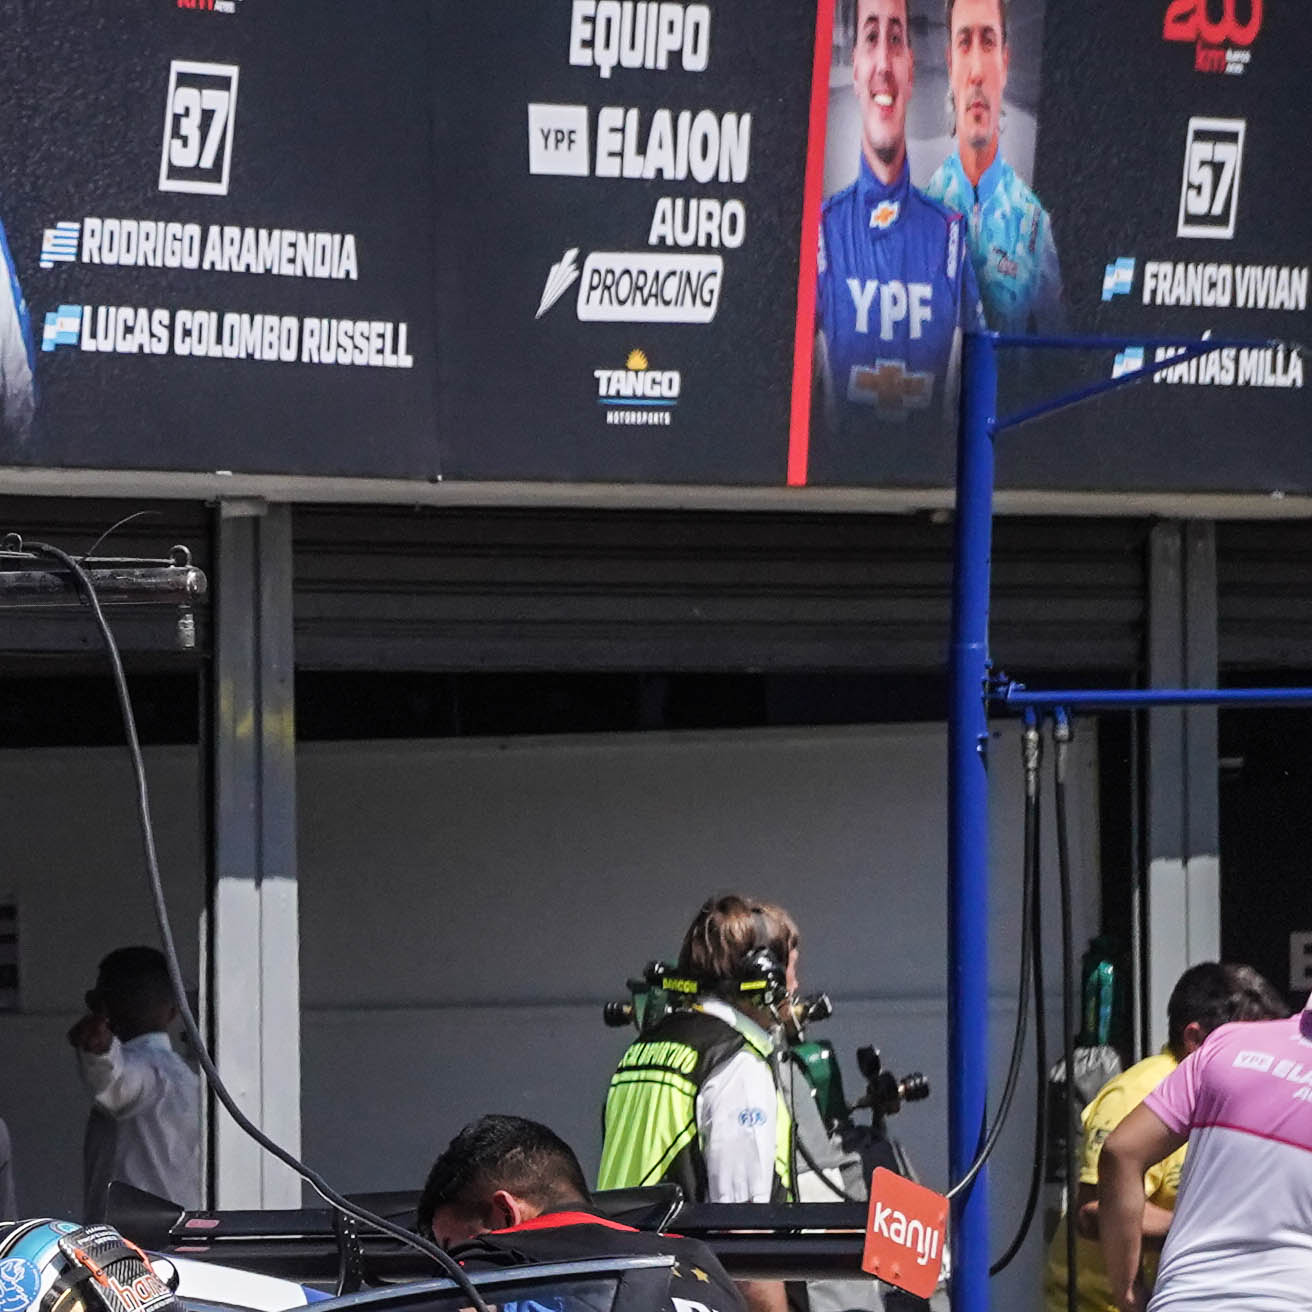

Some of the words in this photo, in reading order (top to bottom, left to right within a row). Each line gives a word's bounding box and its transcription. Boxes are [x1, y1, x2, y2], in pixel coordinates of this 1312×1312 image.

[569, 0, 712, 79] EQUIPO
[169, 86, 231, 169] 37
[540, 128, 577, 152] YPF
[595, 106, 752, 183] ELAION
[1187, 141, 1237, 216] 57
[81, 217, 202, 269] RODRIGO
[202, 225, 358, 281] ARAMENDIA
[648, 198, 746, 248] AURO
[583, 268, 718, 308] PRORACING
[846, 278, 933, 341] YPF
[1142, 261, 1230, 308] FRANCO
[1233, 264, 1310, 311] VIVIAN
[81, 305, 170, 355] LUCAS
[174, 309, 298, 362] COLOMBO
[301, 317, 414, 369] RUSSELL
[593, 368, 681, 398] TANGO
[606, 410, 672, 426] MOTORSPORTS
[873, 1201, 941, 1268] kanji
